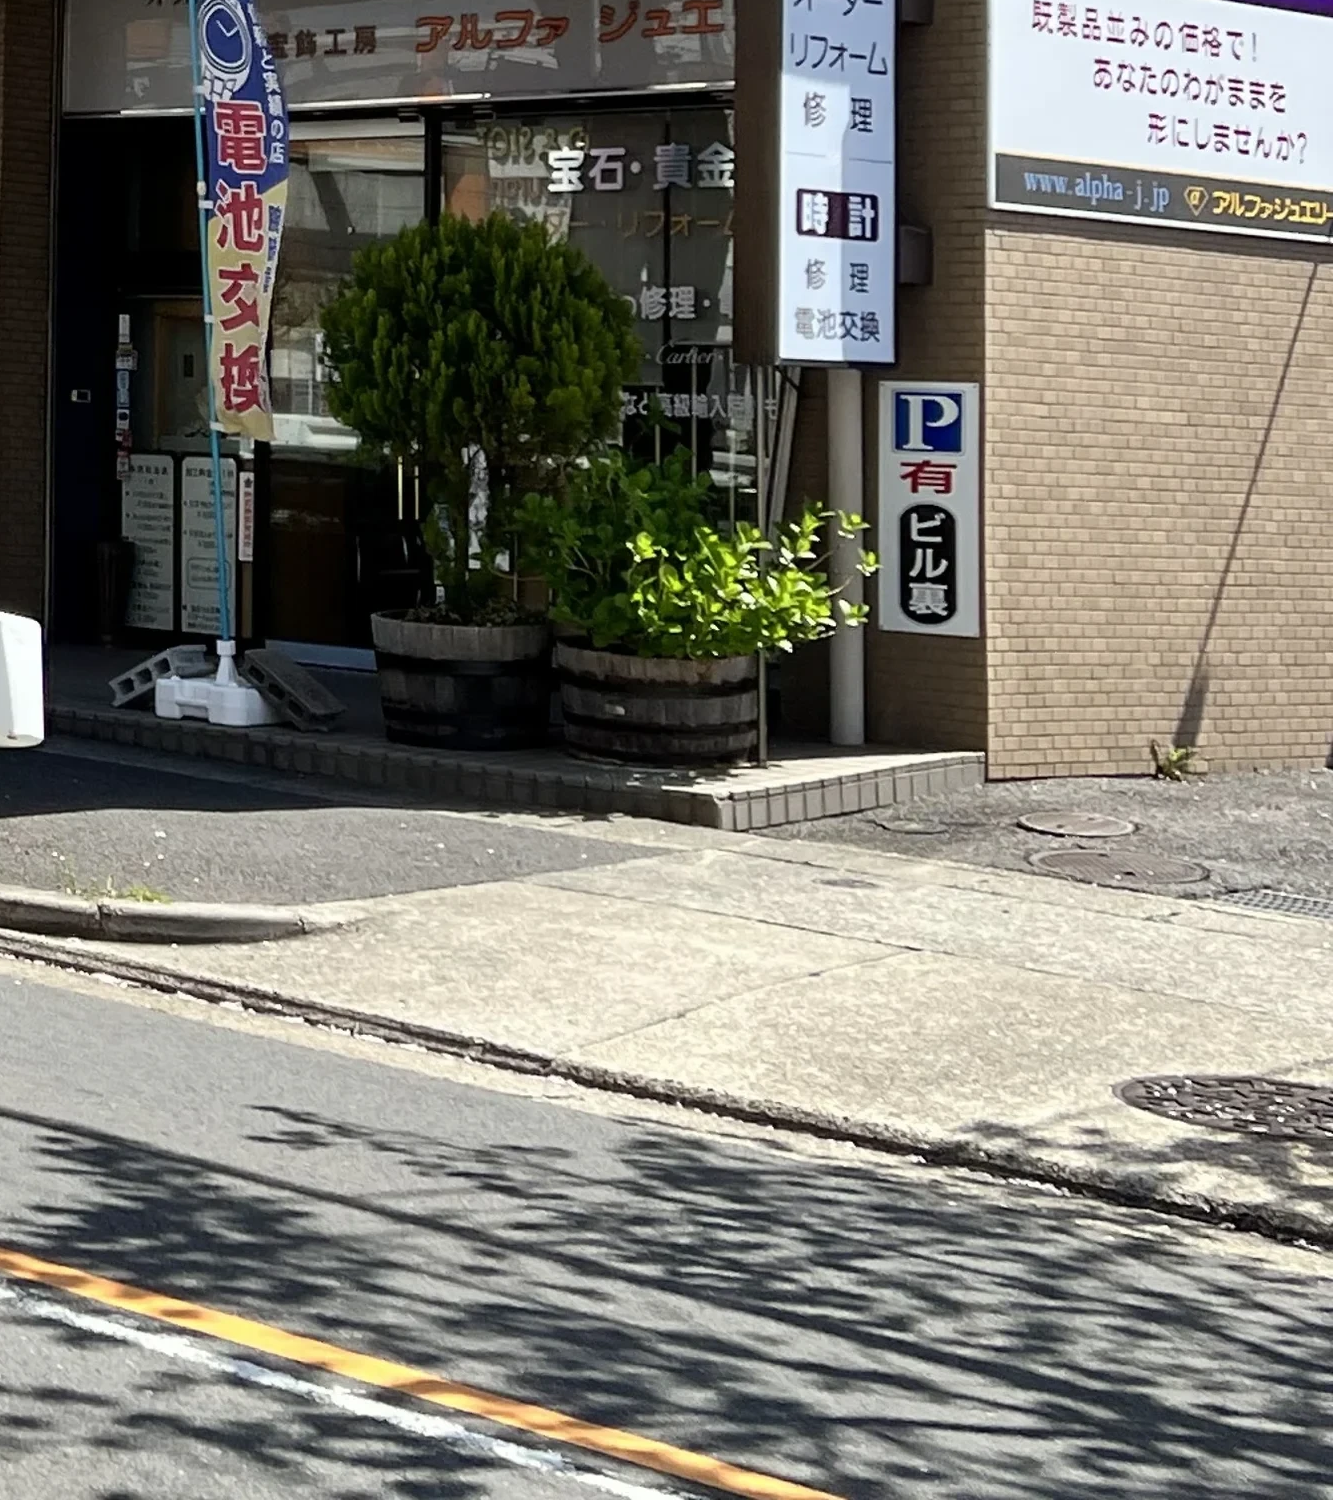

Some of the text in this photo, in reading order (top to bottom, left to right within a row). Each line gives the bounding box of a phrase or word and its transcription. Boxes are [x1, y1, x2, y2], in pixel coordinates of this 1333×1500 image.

[415, 9, 570, 53] アルファ
[790, 32, 888, 76] リフォーム
[1093, 58, 1286, 113] あなたのわがままを
[803, 91, 873, 134] 修理
[1024, 171, 1169, 213] www.alpha-j.jp
[1212, 190, 1333, 225] アルファジュエリー
[801, 192, 875, 239] 時計
[214, 100, 268, 414] 電池交換
[804, 258, 869, 294] 修理
[794, 307, 880, 343] 電池交換
[899, 394, 960, 451] P
[900, 460, 958, 495] 有
[909, 512, 949, 617] ビル裏
